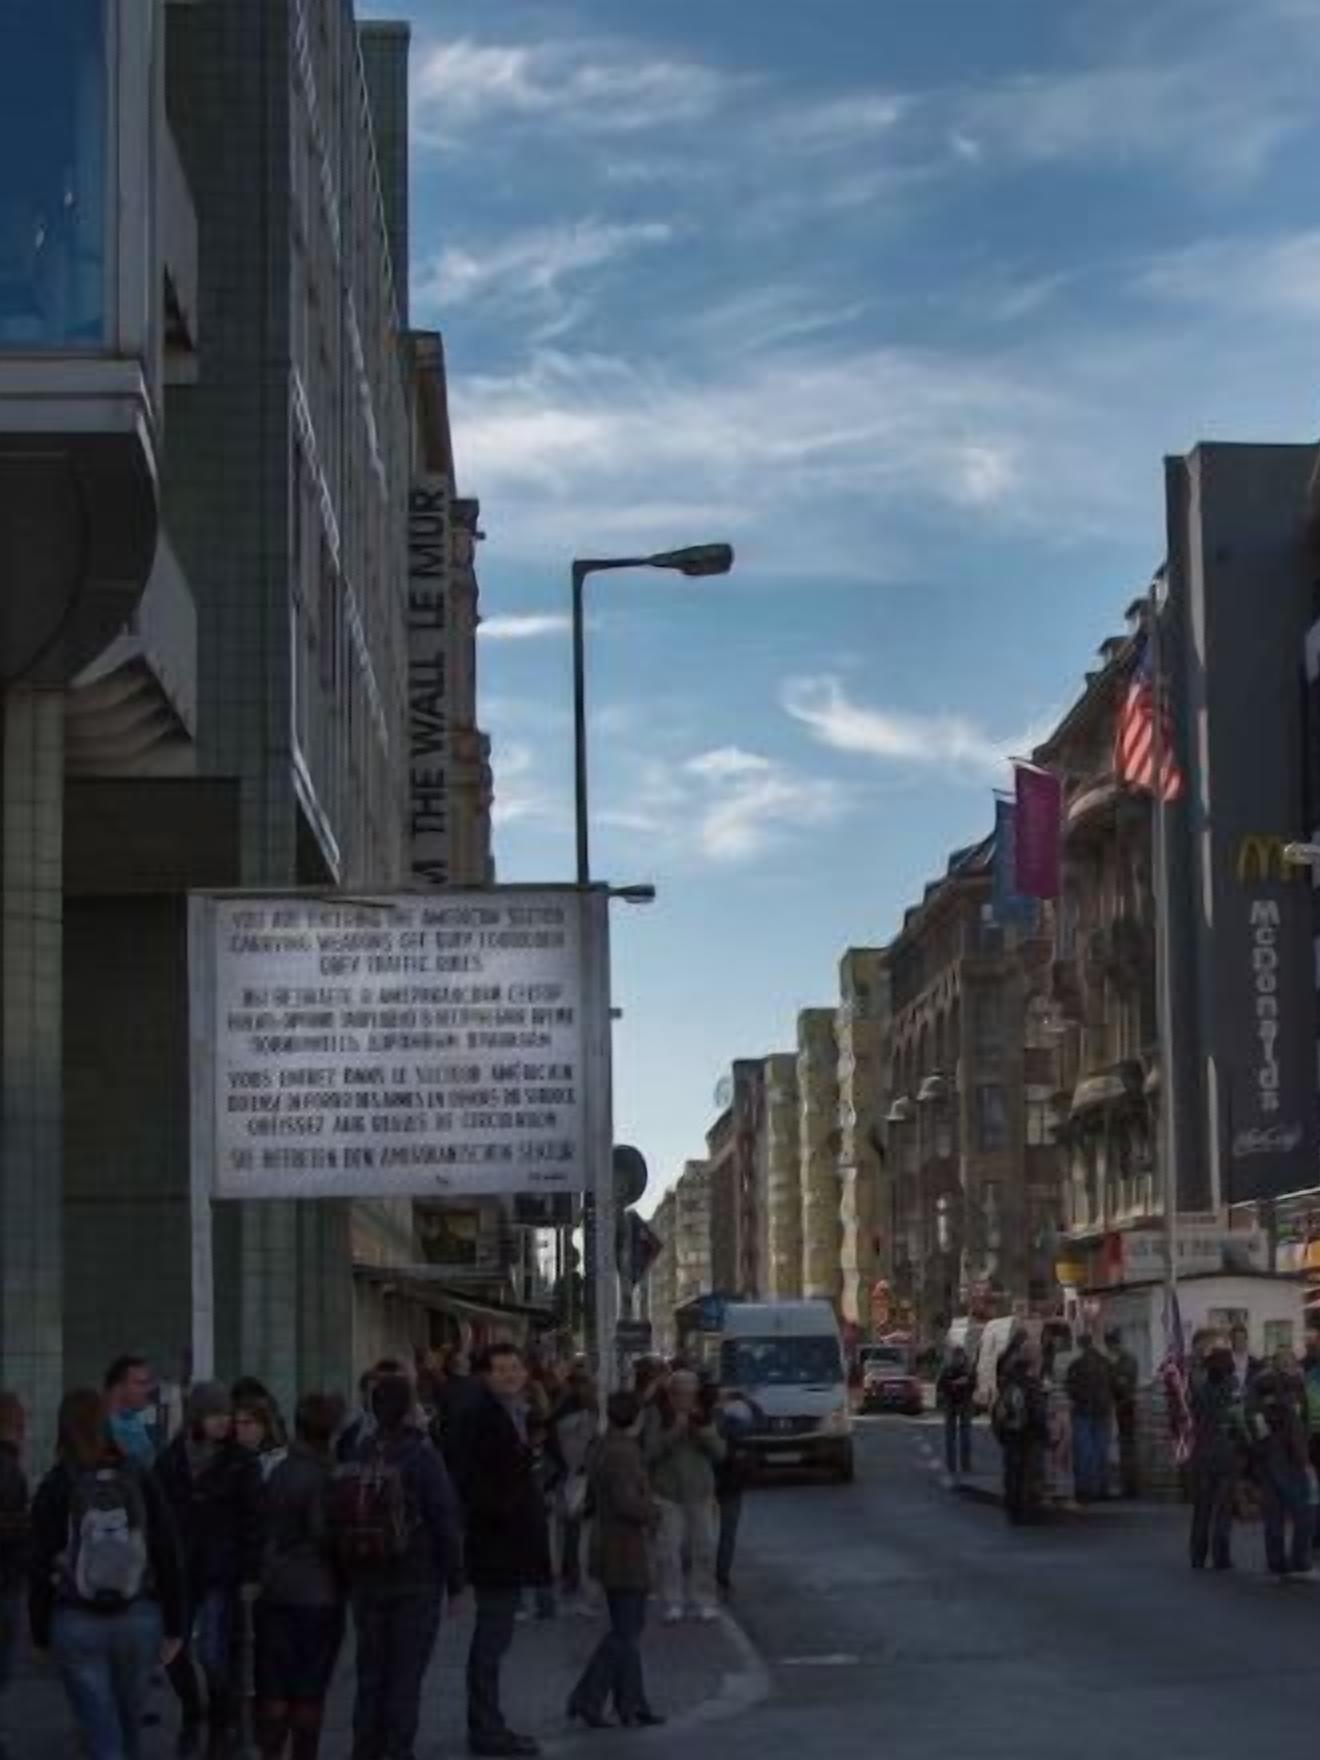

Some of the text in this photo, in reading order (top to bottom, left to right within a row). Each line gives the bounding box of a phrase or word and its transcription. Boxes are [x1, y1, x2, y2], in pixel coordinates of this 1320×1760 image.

[407, 490, 446, 578] MUR
[407, 591, 445, 630] LE
[407, 652, 446, 759] WALL
[408, 767, 446, 837] THE
